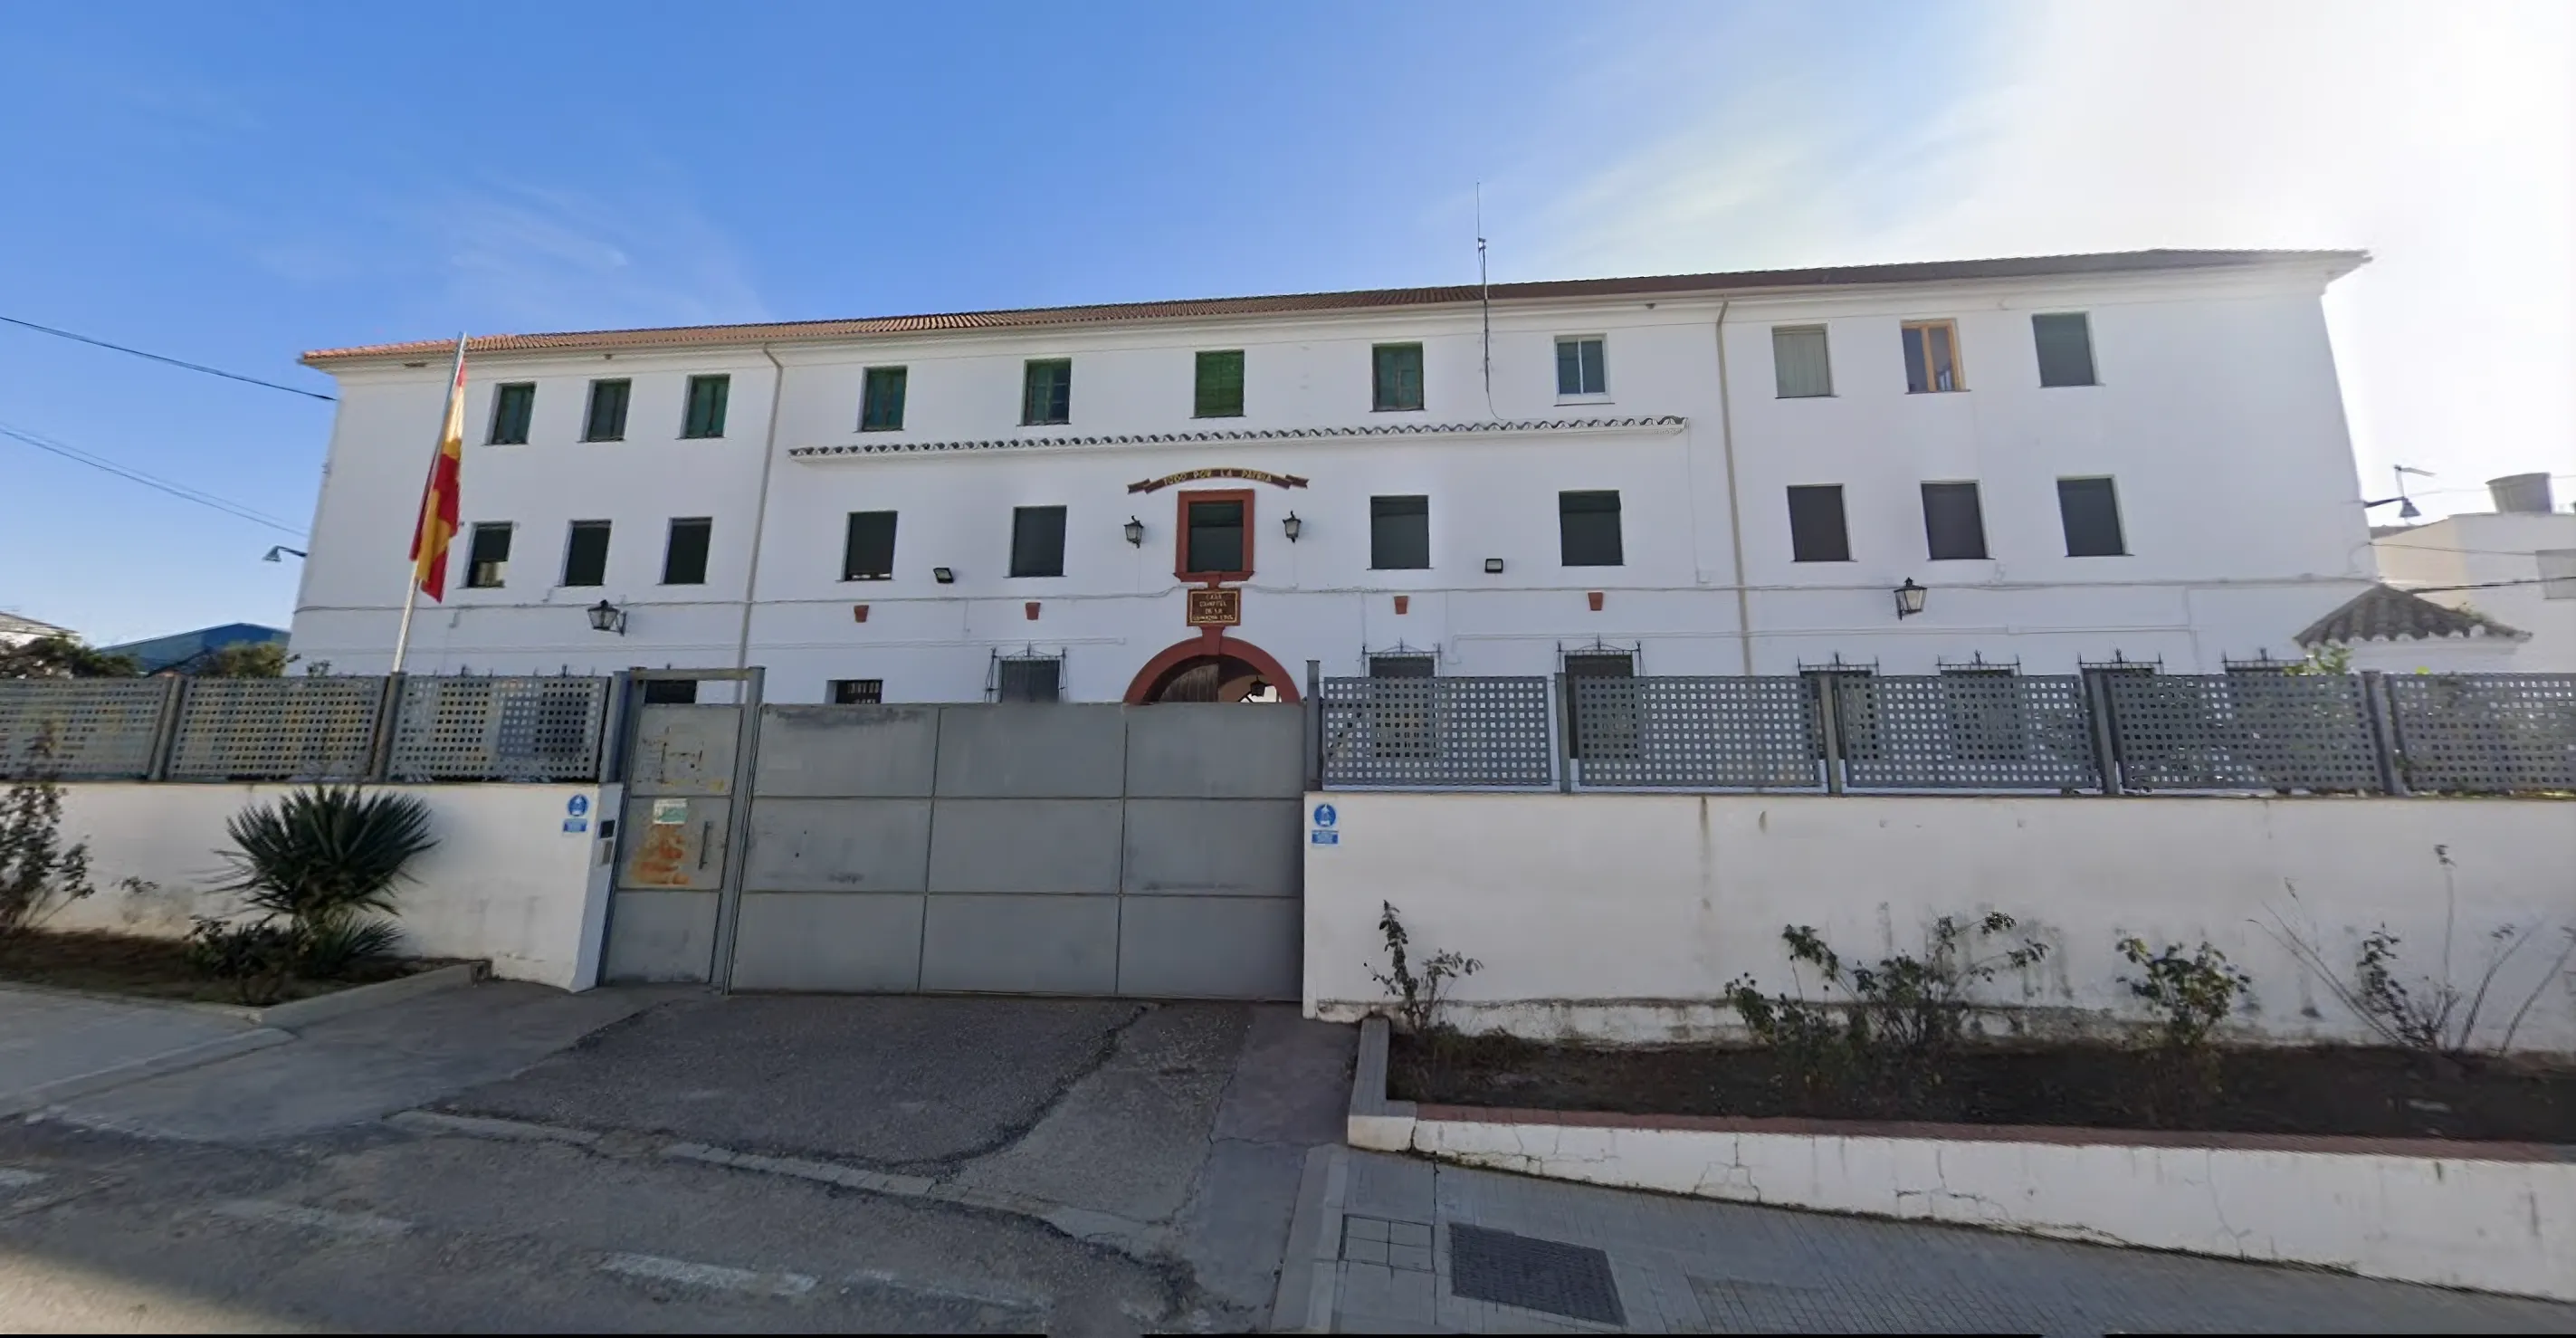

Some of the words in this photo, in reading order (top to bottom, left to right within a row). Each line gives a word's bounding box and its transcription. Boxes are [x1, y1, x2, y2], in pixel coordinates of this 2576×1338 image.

[1163, 473, 1188, 485] TODO
[1193, 470, 1212, 479] POR
[1220, 469, 1233, 478] LA
[1241, 470, 1272, 483] PATRIA
